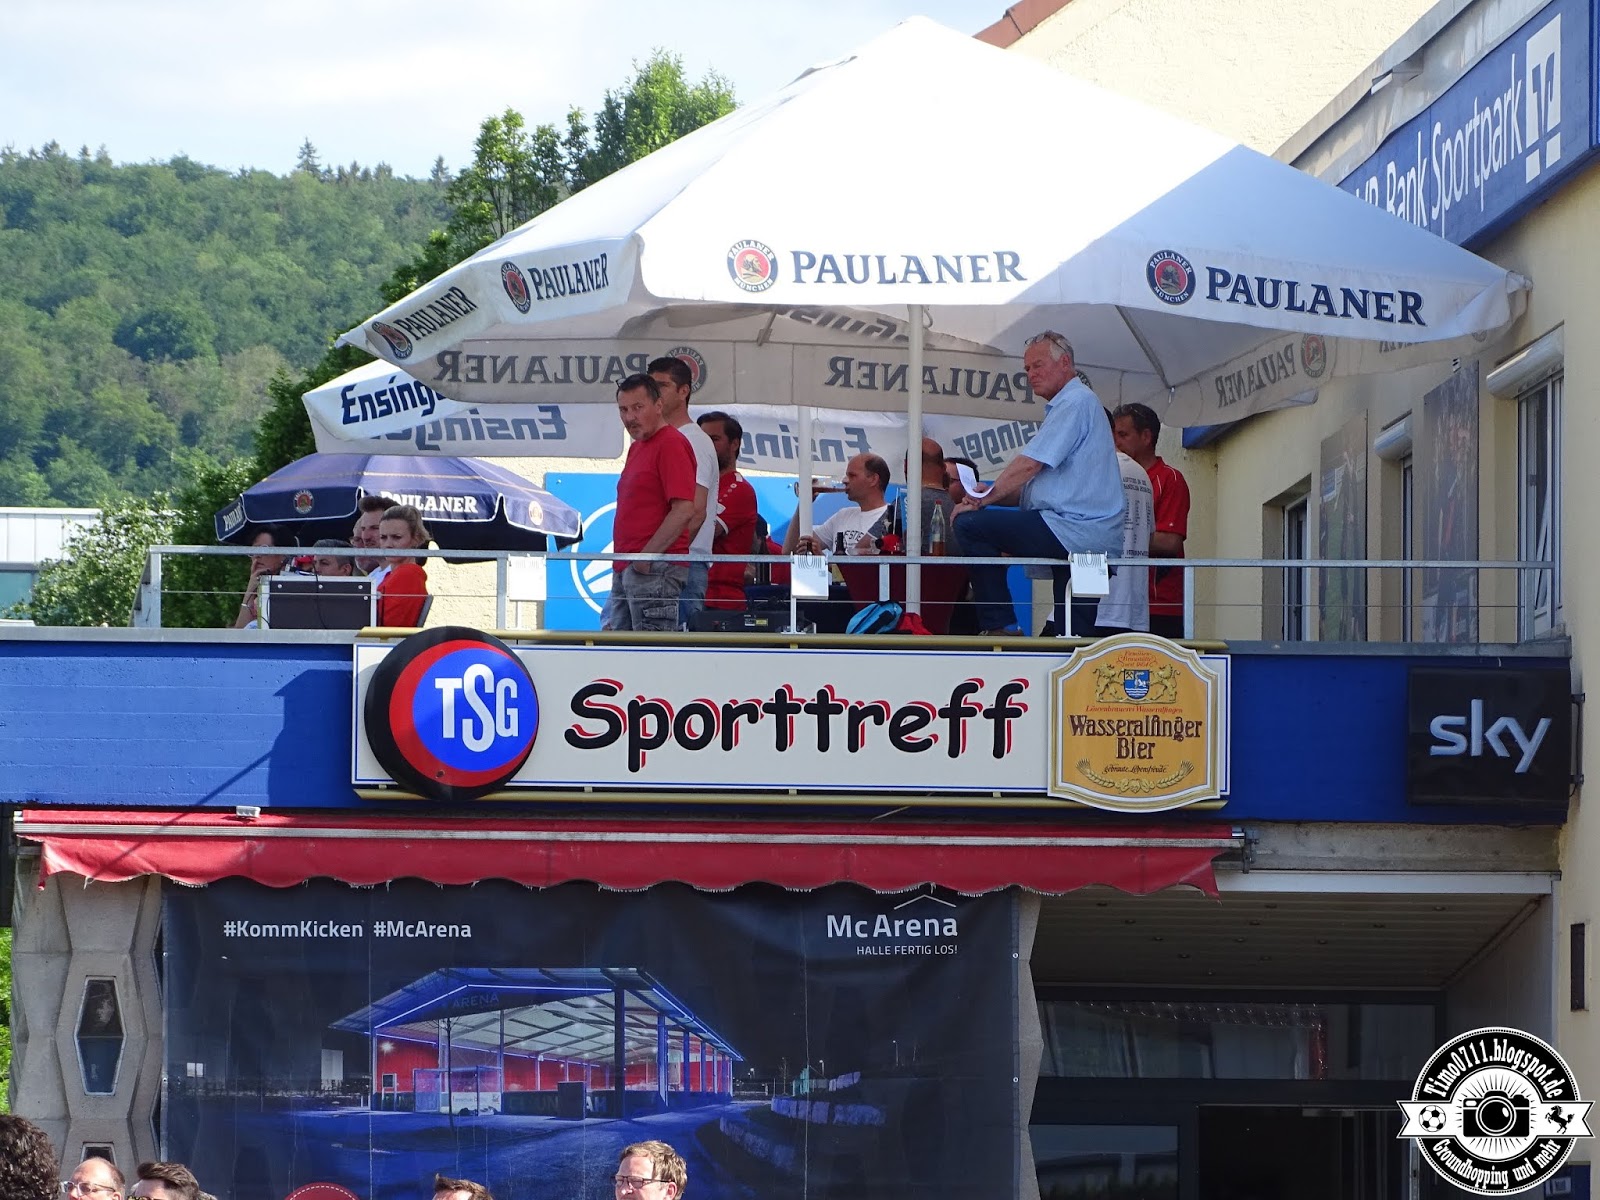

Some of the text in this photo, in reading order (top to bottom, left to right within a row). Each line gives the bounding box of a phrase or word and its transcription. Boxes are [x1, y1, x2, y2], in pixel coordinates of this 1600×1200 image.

[1386, 131, 1428, 228] Bank
[1431, 53, 1523, 239] Sportpark
[527, 253, 610, 300] PAULANER
[790, 250, 1027, 285] PAULANER
[1150, 251, 1193, 275] PAULANER
[394, 286, 479, 341] PAULANER
[1206, 266, 1426, 327] PAULANER
[341, 376, 449, 425] Ensing
[435, 663, 519, 752] TSG
[564, 678, 1030, 773] Sporttreff
[1069, 714, 1203, 743] Wasseralfinger
[1116, 737, 1156, 760] Bier
[1429, 698, 1552, 774] sky
[224, 920, 472, 938] #KommKicken #McArena
[827, 914, 958, 938] McArena
[856, 944, 958, 955] HALLE FERTIG LOS!
[452, 993, 500, 1009] ARENA
